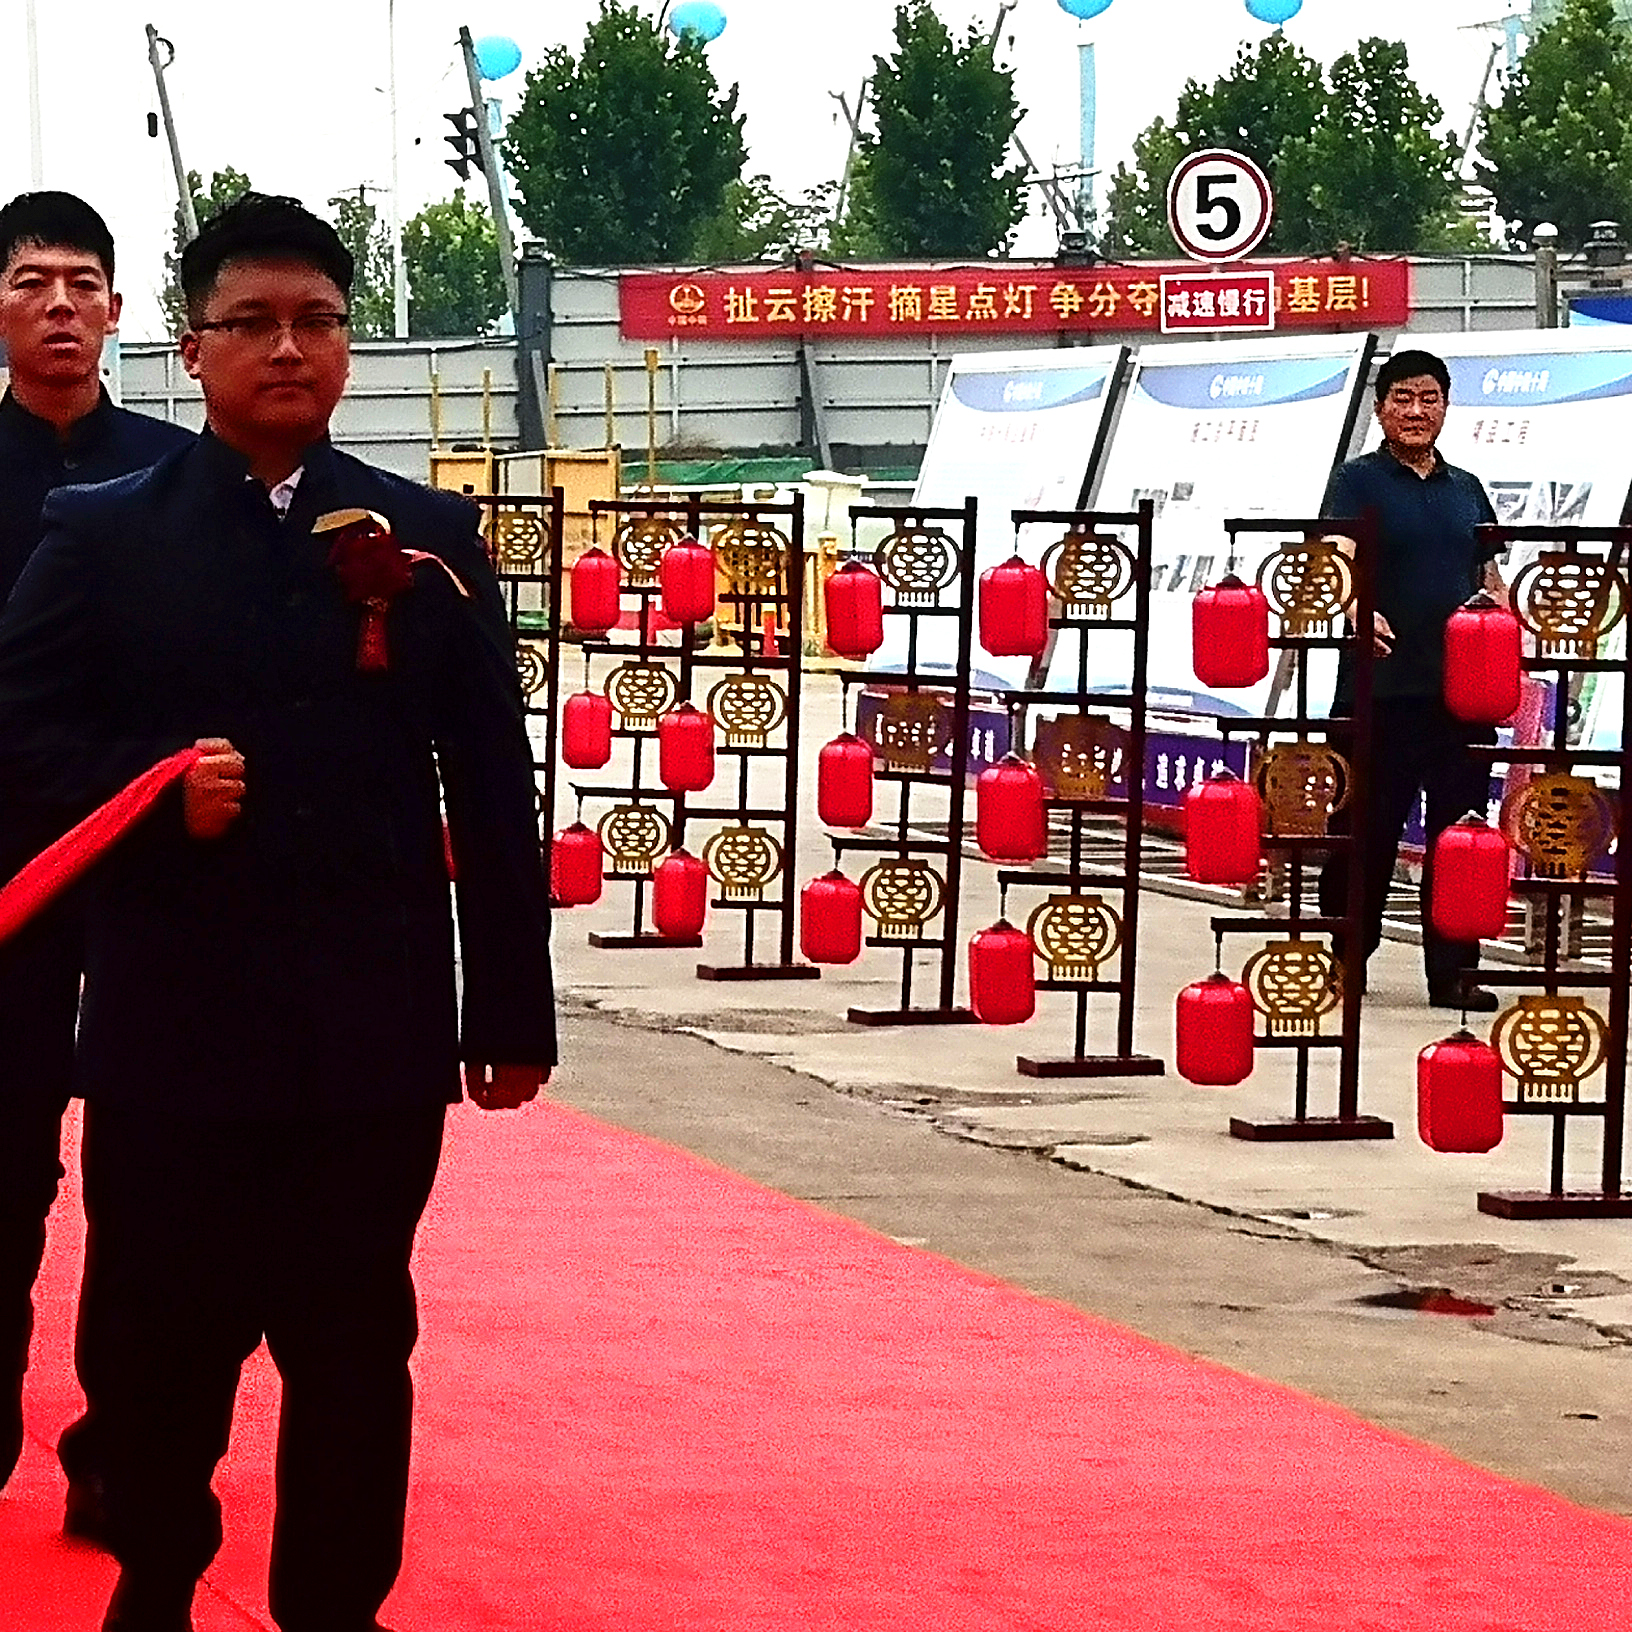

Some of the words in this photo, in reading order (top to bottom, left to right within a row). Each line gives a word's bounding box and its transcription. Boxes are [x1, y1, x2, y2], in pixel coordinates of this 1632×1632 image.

[1196, 174, 1241, 241] 5
[724, 284, 875, 323] 扯云擦汗
[888, 282, 1038, 321] 摘星点灯
[1049, 281, 1159, 318] 争分夺
[1273, 275, 1369, 314] 基层!
[1167, 288, 1266, 319] 减速慢行
